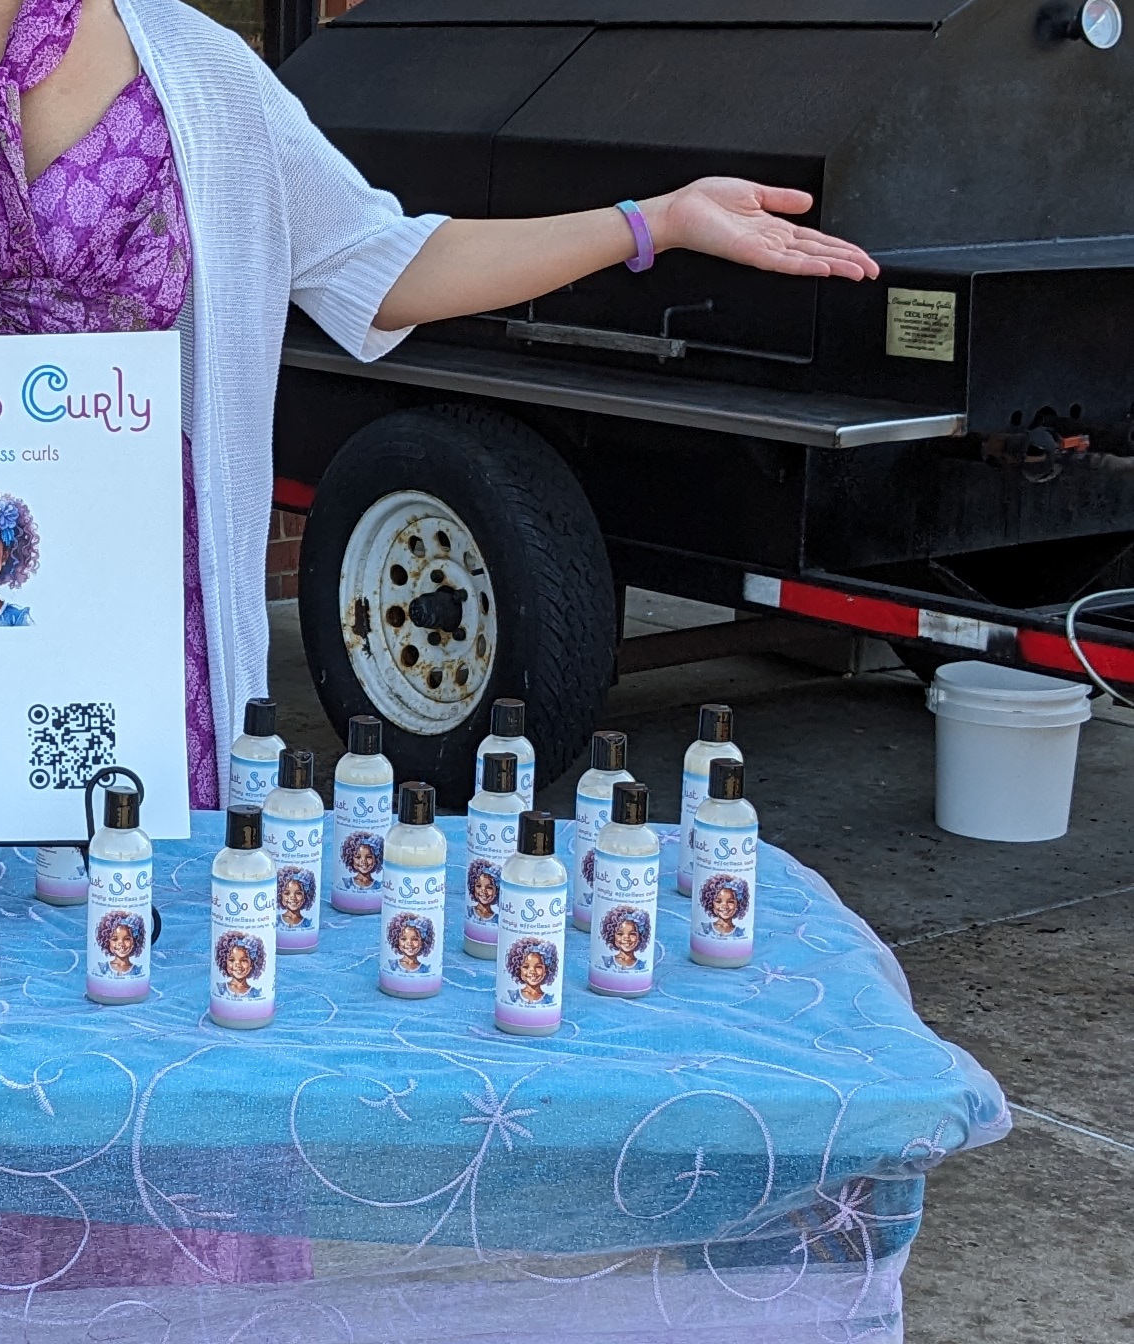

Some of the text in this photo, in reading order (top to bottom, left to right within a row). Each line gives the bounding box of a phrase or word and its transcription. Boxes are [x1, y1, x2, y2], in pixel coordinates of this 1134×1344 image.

[21, 363, 152, 433] Curly
[21, 444, 60, 462] curls
[230, 773, 242, 785] ust
[245, 771, 266, 792] So
[335, 799, 349, 811] ust
[352, 796, 374, 818] So
[577, 813, 590, 825] ust
[282, 830, 304, 852] So
[476, 823, 495, 846] So
[714, 837, 737, 860] So
[89, 876, 104, 889] ust
[108, 872, 132, 895] So
[399, 877, 420, 899] So
[595, 870, 611, 883] ust
[616, 868, 639, 891] So
[225, 892, 248, 916] So
[500, 901, 516, 915] ust
[520, 898, 544, 923] So
